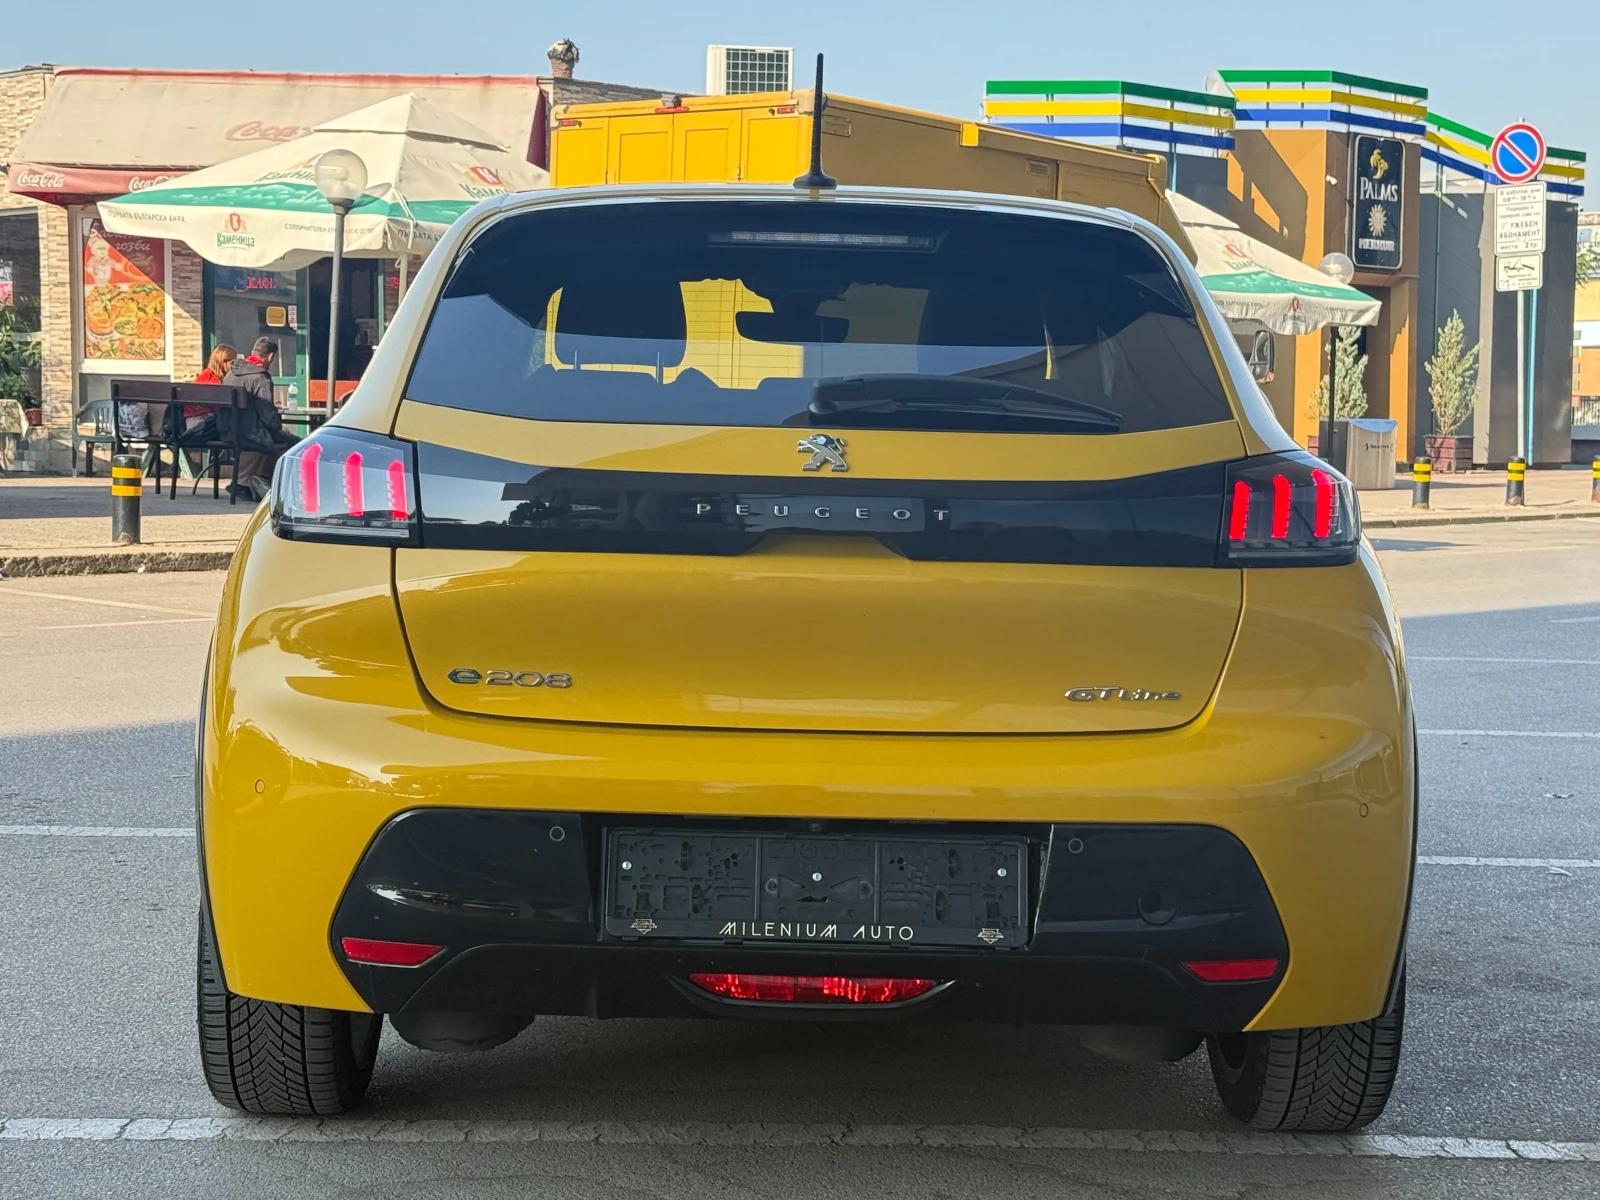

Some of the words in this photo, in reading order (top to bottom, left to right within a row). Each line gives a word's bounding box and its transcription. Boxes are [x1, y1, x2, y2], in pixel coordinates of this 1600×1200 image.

[1360, 177, 1399, 202] PALMS
[216, 232, 255, 248] Каменица
[1499, 229, 1541, 239] АБОНАМЕНТ
[696, 503, 949, 521] PEUGEOT
[719, 921, 837, 939] MILENIUM
[853, 925, 914, 941] AUTO
